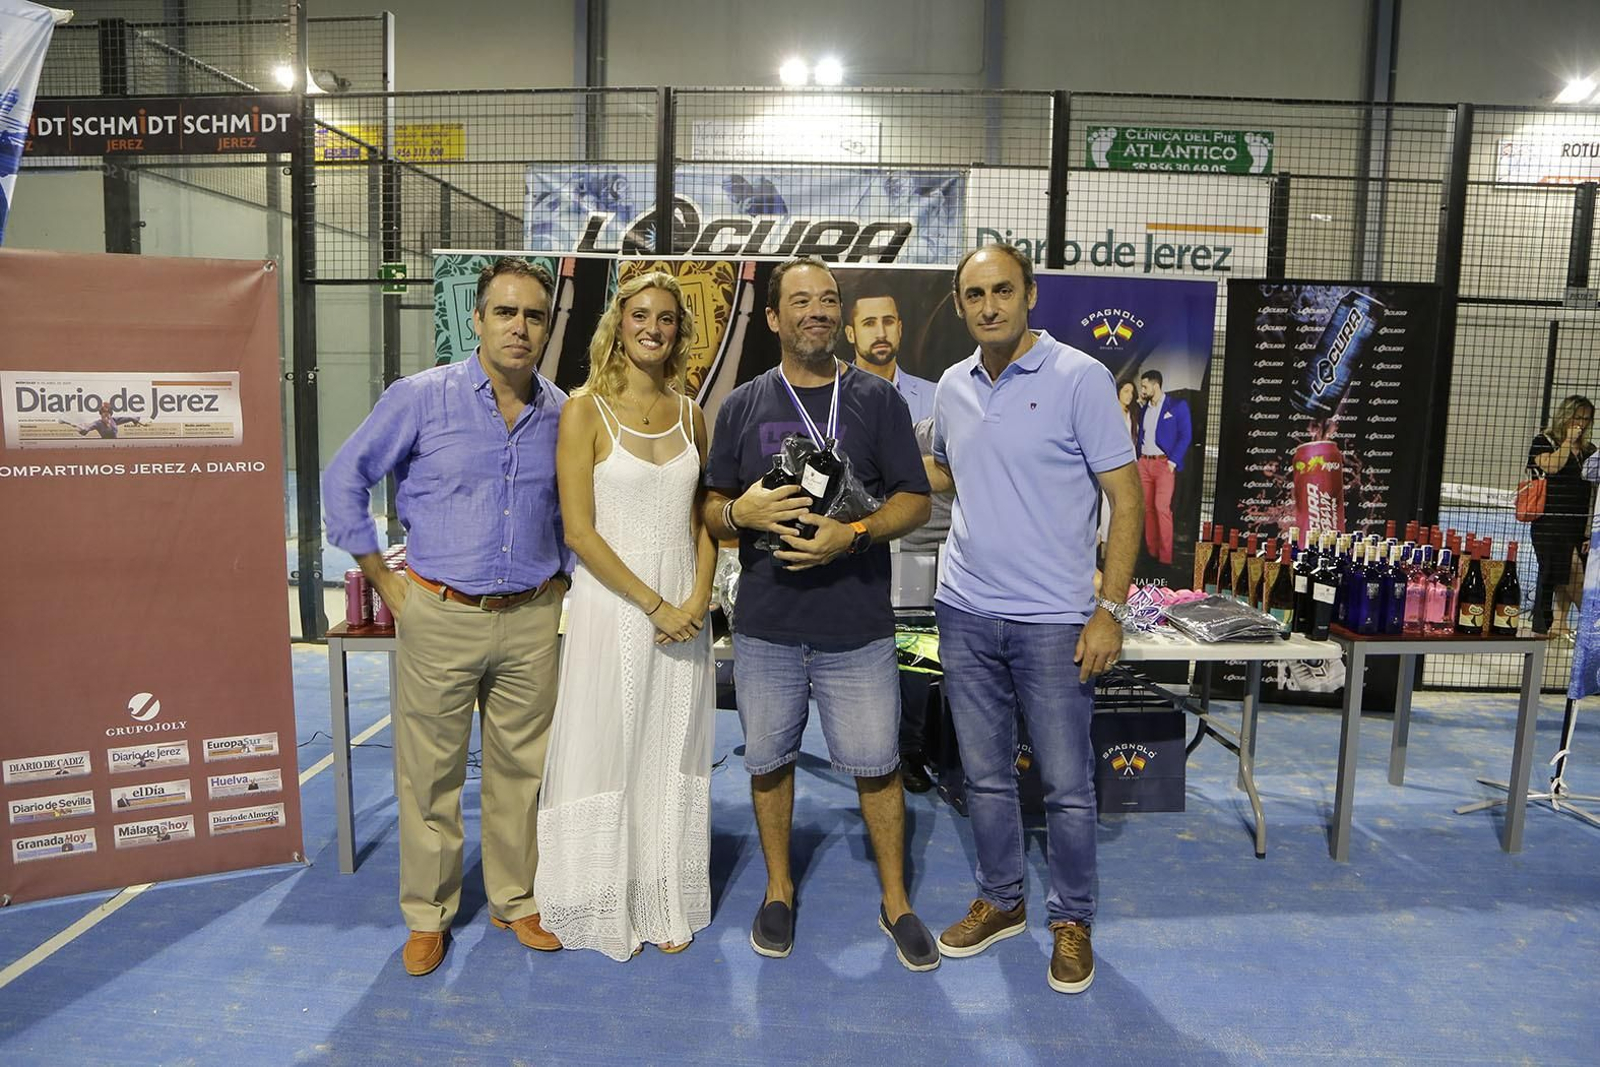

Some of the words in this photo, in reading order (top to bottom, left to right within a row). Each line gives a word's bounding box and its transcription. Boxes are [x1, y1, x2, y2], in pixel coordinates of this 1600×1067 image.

[106, 138, 145, 152] JEREZ
[217, 136, 257, 151] JEREZ
[1561, 142, 1600, 158] ROTU
[577, 194, 912, 263] LOCURA
[1091, 229, 1136, 268] de
[1143, 233, 1232, 273] Jerez
[1258, 306, 1288, 315] LOCURA
[1081, 309, 1144, 328] SPAGNOLO
[1256, 324, 1287, 333] LOCURA
[1255, 342, 1286, 350] LOCURA
[1373, 345, 1404, 353] LOCURA
[1311, 307, 1364, 397] LOCURA
[1254, 360, 1284, 368] LOCURA
[1372, 362, 1402, 370] LOCURA
[1252, 377, 1283, 386] LOCURA
[1370, 380, 1401, 388] LOCURA
[15, 387, 103, 413] Diario
[109, 387, 145, 413] de
[150, 388, 219, 420] Jerez
[1251, 395, 1281, 403] LOCURA
[1368, 397, 1398, 405] LOCURA
[1249, 412, 1280, 420] LOCURA
[1367, 415, 1397, 423] LOCURA
[1248, 430, 1278, 438] LOCURA
[1365, 432, 1395, 440] LOCURA
[1246, 447, 1276, 455] LOCURA
[1363, 449, 1393, 457] LOCURA
[0, 464, 125, 477] OMPARTIMOS
[130, 462, 187, 475] JEREZ
[190, 462, 202, 473] A
[207, 461, 265, 473] DIARIO
[1307, 483, 1321, 532] CURA
[112, 752, 141, 762] Diario
[143, 749, 155, 759] de
[157, 748, 181, 760] Jerez
[1102, 743, 1154, 759] SPAGNOLO
[9, 762, 42, 773] DIARIO
[44, 760, 56, 769] DE
[211, 775, 249, 787] Huelva
[13, 803, 44, 814] Diario
[45, 801, 57, 810] de
[58, 797, 91, 808] Sevilla
[118, 824, 160, 837] Málaga
[168, 820, 188, 831] hoy
